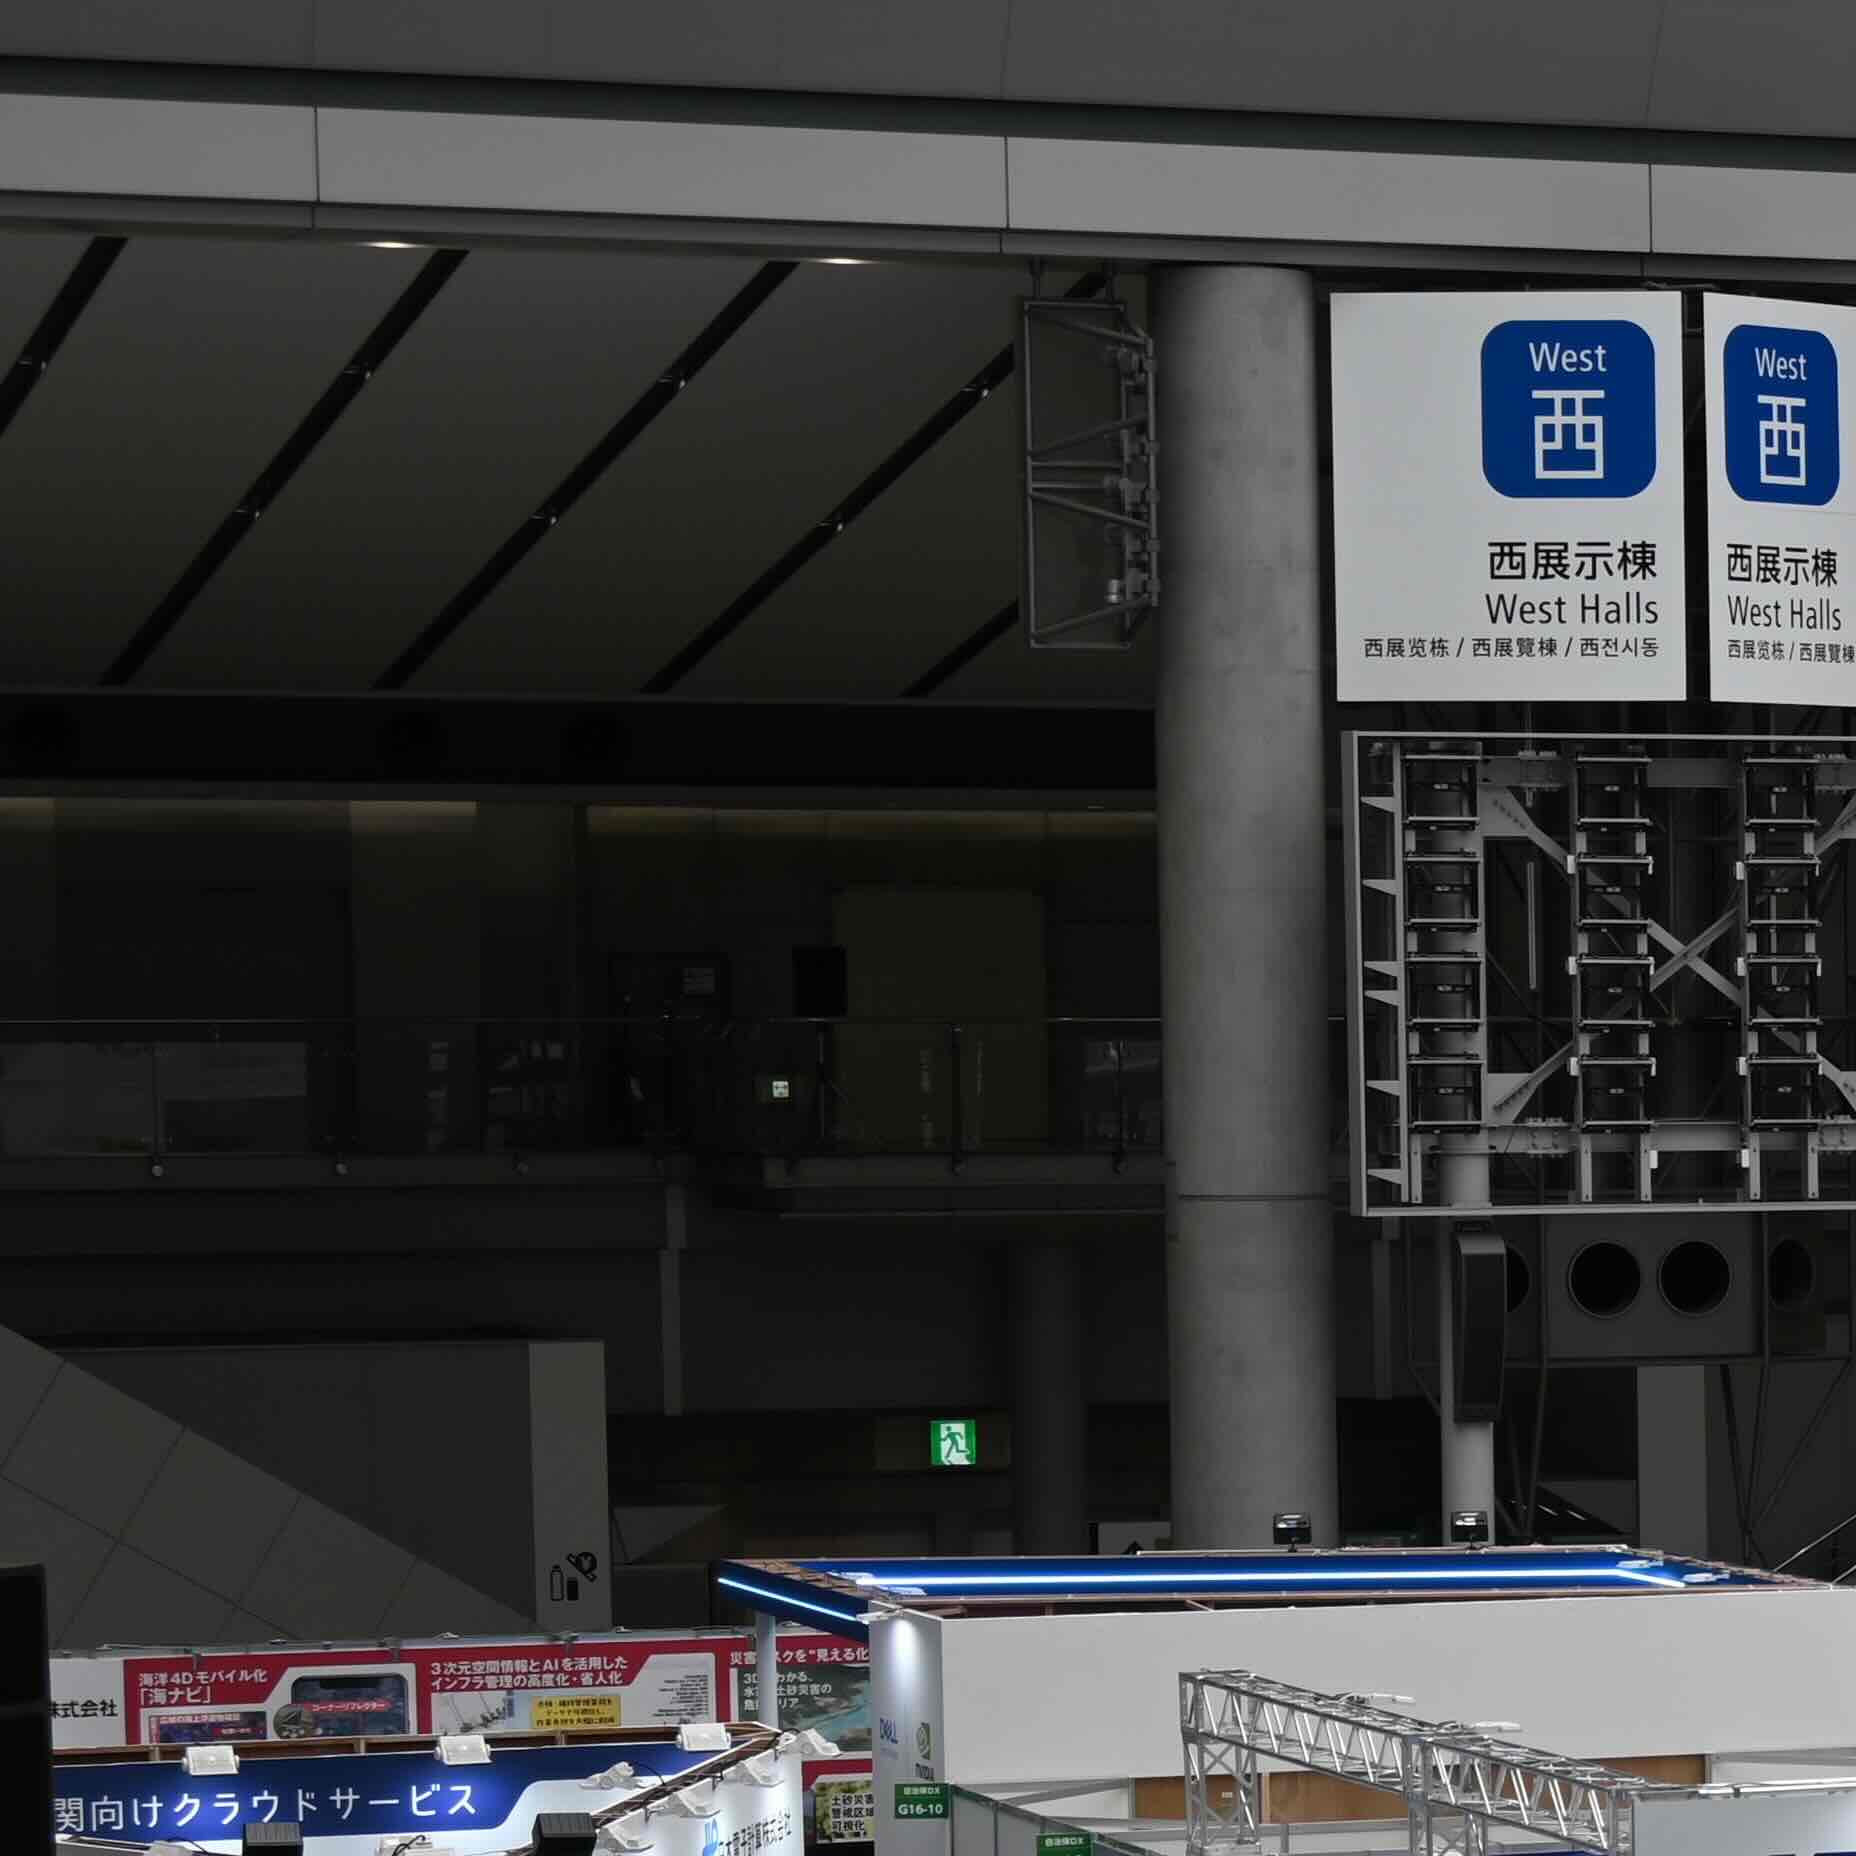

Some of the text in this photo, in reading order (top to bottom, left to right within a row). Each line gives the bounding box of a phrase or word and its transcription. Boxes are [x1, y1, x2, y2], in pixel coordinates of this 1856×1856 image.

[1529, 342, 1607, 373] West
[1755, 347, 1807, 381] West
[1531, 389, 1605, 480] 西
[1757, 395, 1806, 487] 西
[1488, 541, 1658, 582] 西展示棟
[1727, 544, 1839, 588] 西展示棟
[1485, 593, 1659, 626] West Halls
[1728, 595, 1842, 632] West Halls
[1364, 638, 1450, 659] 西展览栋
[139, 1668, 268, 1687] 海洋4Dモバイル化
[431, 1655, 628, 1676] 3次元空間情報とAIを活用した
[898, 1801, 944, 1817] G16-10
